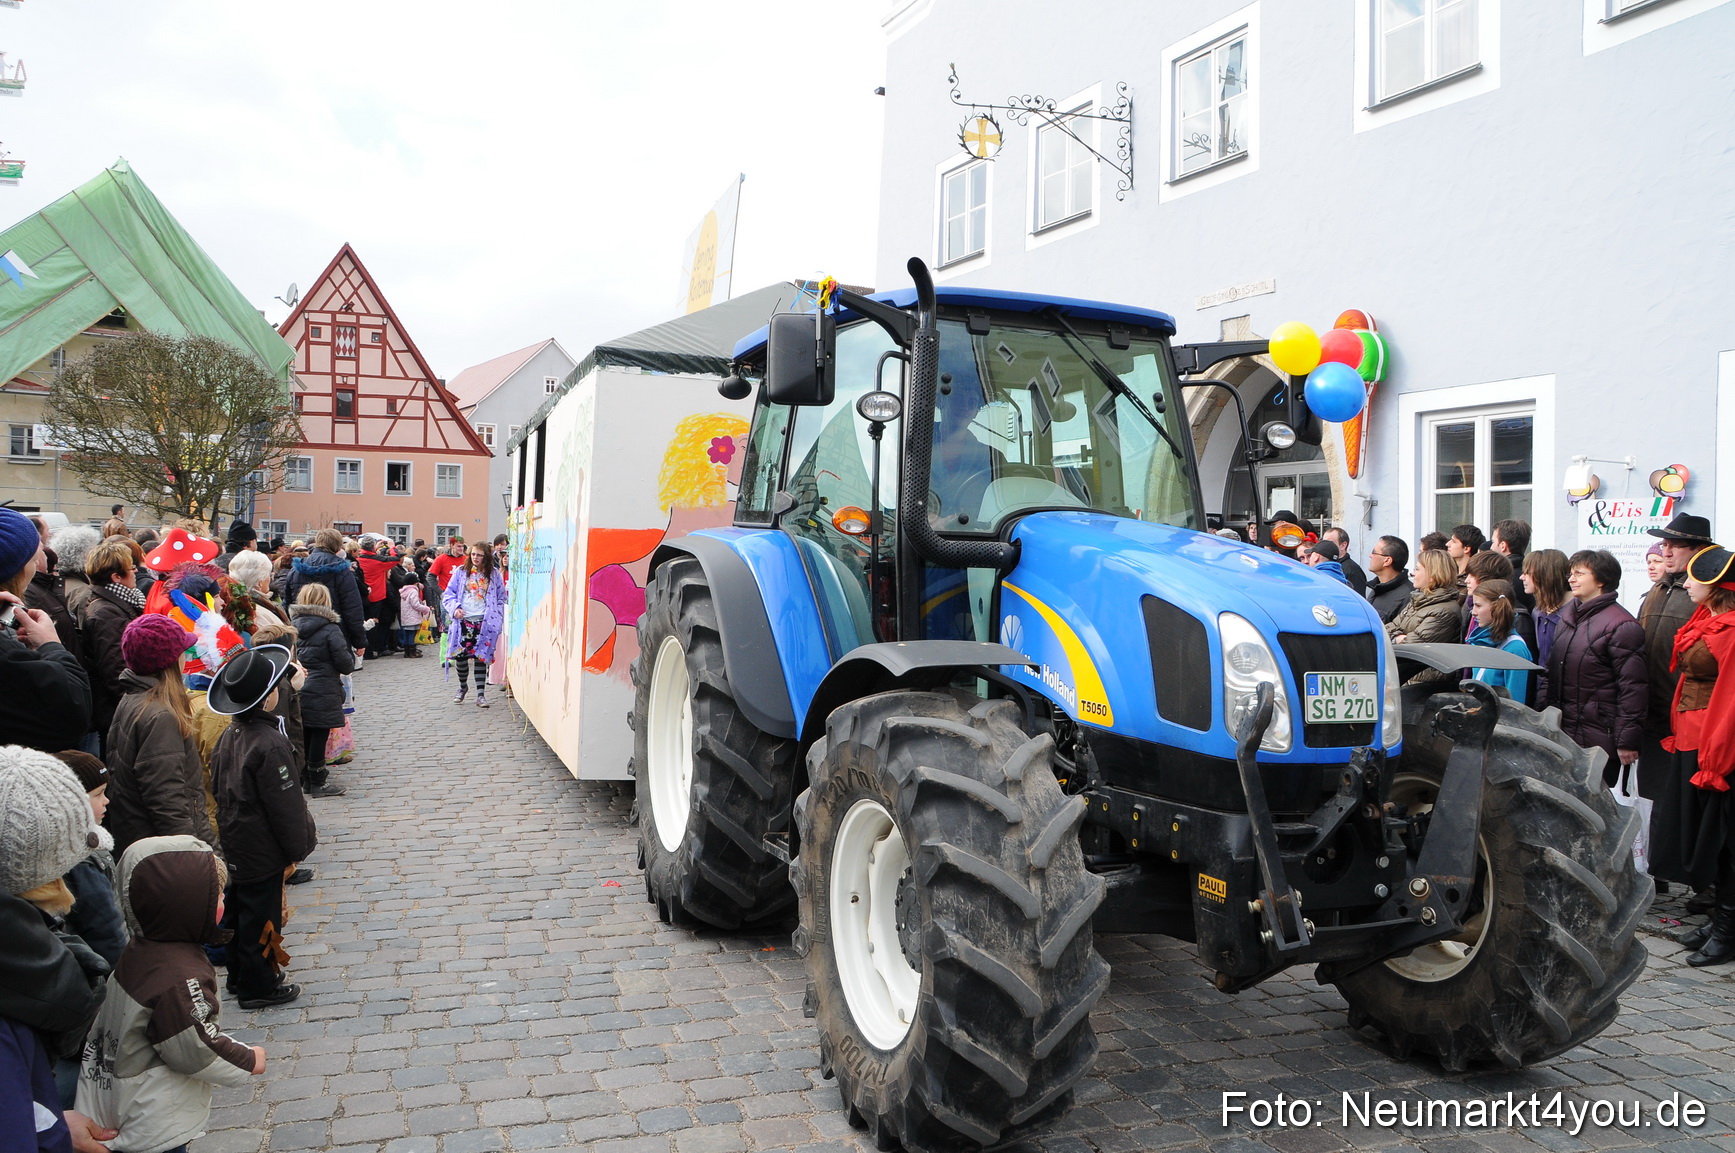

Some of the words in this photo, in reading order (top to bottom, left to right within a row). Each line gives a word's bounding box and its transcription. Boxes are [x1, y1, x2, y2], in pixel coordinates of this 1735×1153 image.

[1588, 500, 1611, 528] &
[1611, 502, 1642, 518] Eis
[1043, 663, 1075, 708] Holland
[1321, 676, 1345, 696] NM
[1081, 700, 1107, 716] T5050
[1312, 699, 1336, 719] SG
[1344, 698, 1374, 719] 270
[1200, 877, 1225, 895] PAULI
[839, 1034, 889, 1086] TM700
